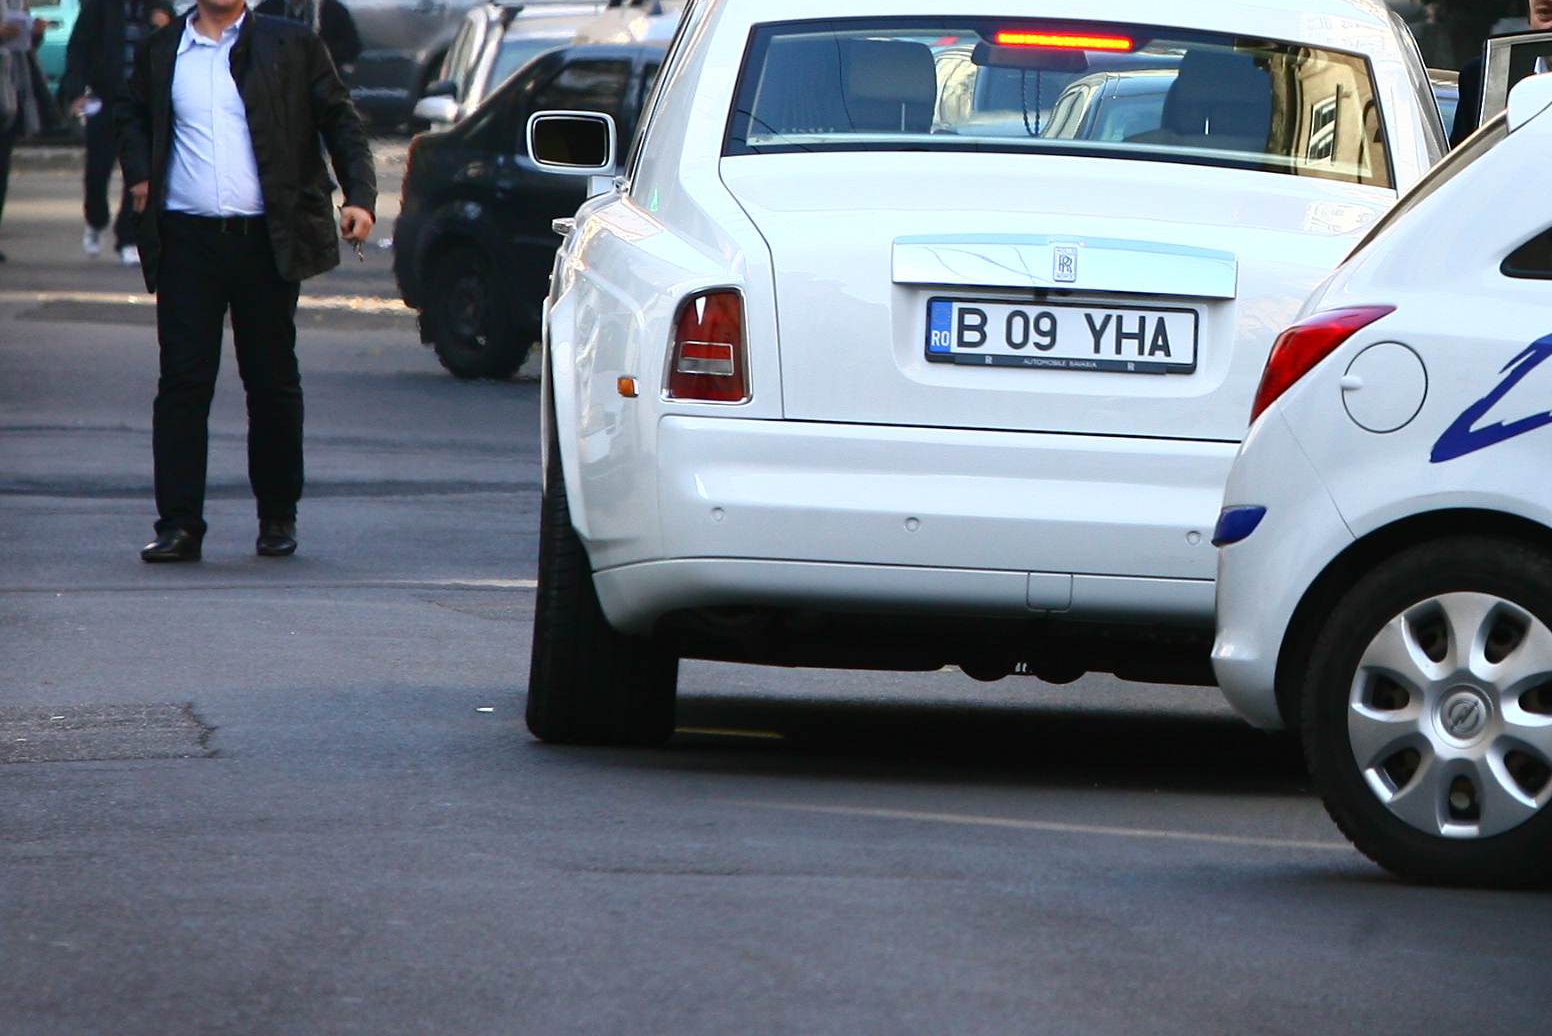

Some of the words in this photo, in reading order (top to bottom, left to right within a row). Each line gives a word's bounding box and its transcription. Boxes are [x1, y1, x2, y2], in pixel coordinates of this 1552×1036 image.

[931, 330, 950, 348] RO
[956, 307, 988, 349] B
[1005, 310, 1057, 351] 09
[1084, 312, 1172, 358] YHA
